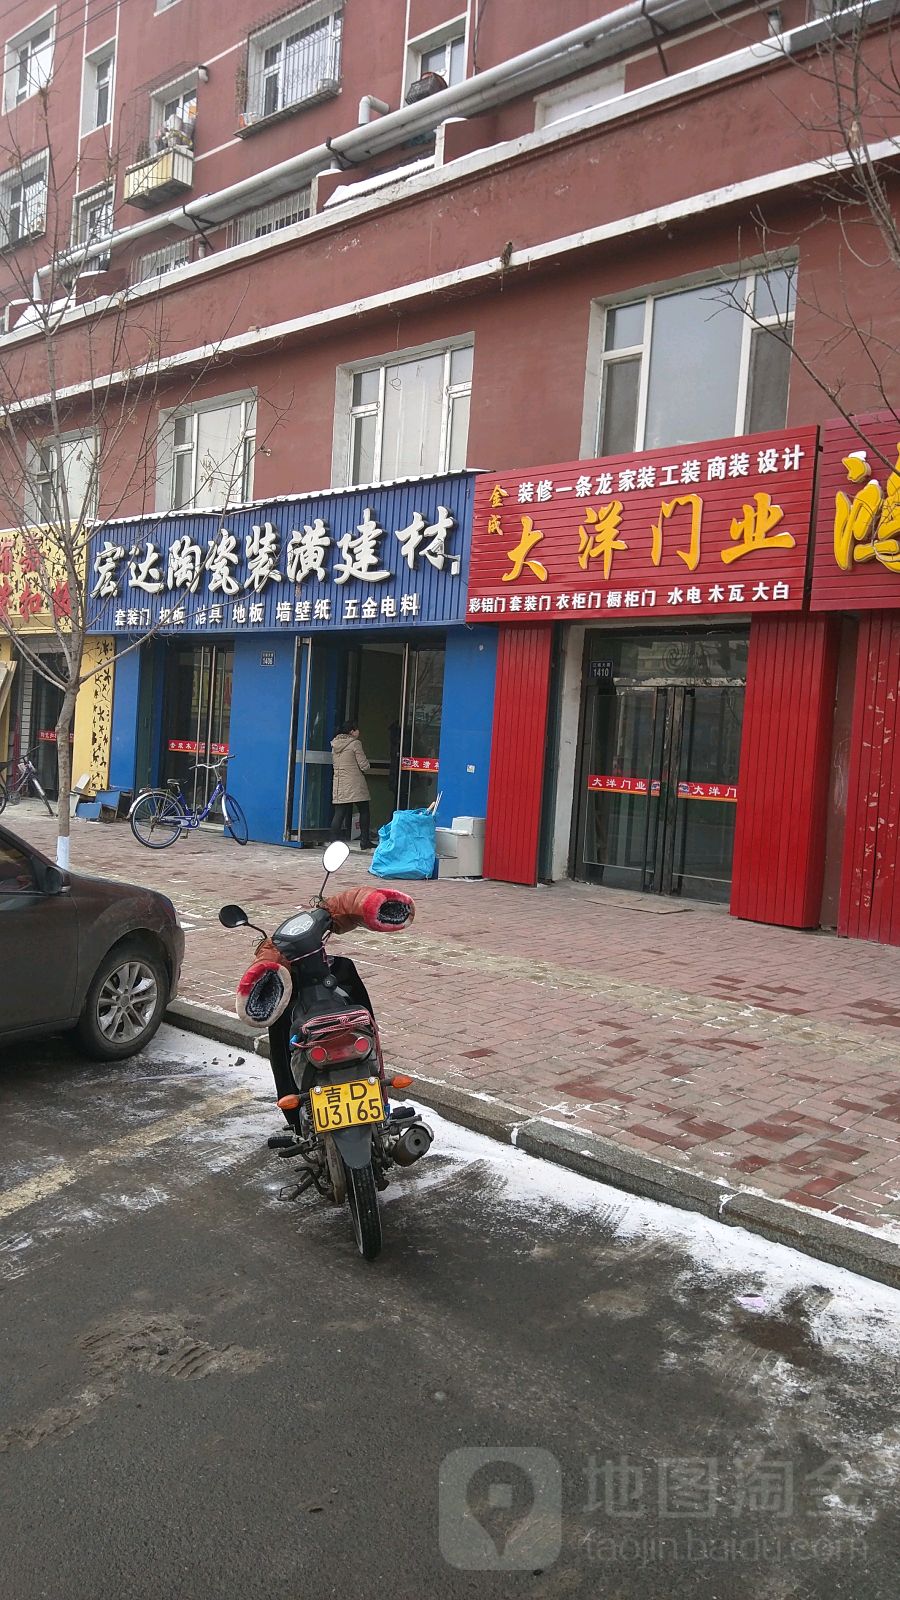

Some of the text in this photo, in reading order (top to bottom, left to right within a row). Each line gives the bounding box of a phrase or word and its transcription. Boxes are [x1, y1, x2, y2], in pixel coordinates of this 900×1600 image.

[517, 444, 806, 503] 装修一条龙 家装 工装 商装 设计
[90, 506, 456, 598] 宏达陶瓷装潢建材
[501, 492, 797, 582] 大洋门业
[114, 607, 150, 627] 套装门
[231, 601, 264, 624] 地板
[275, 598, 331, 623] 墙壁纸
[342, 592, 419, 620] 五金电料
[468, 581, 790, 614] 彩铝门 套装门 衣柜门 橱柜门 水电 木瓦 大白
[593, 667, 609, 677] 1410
[591, 777, 647, 791] 大洋门业
[316, 1098, 381, 1129] U3165
